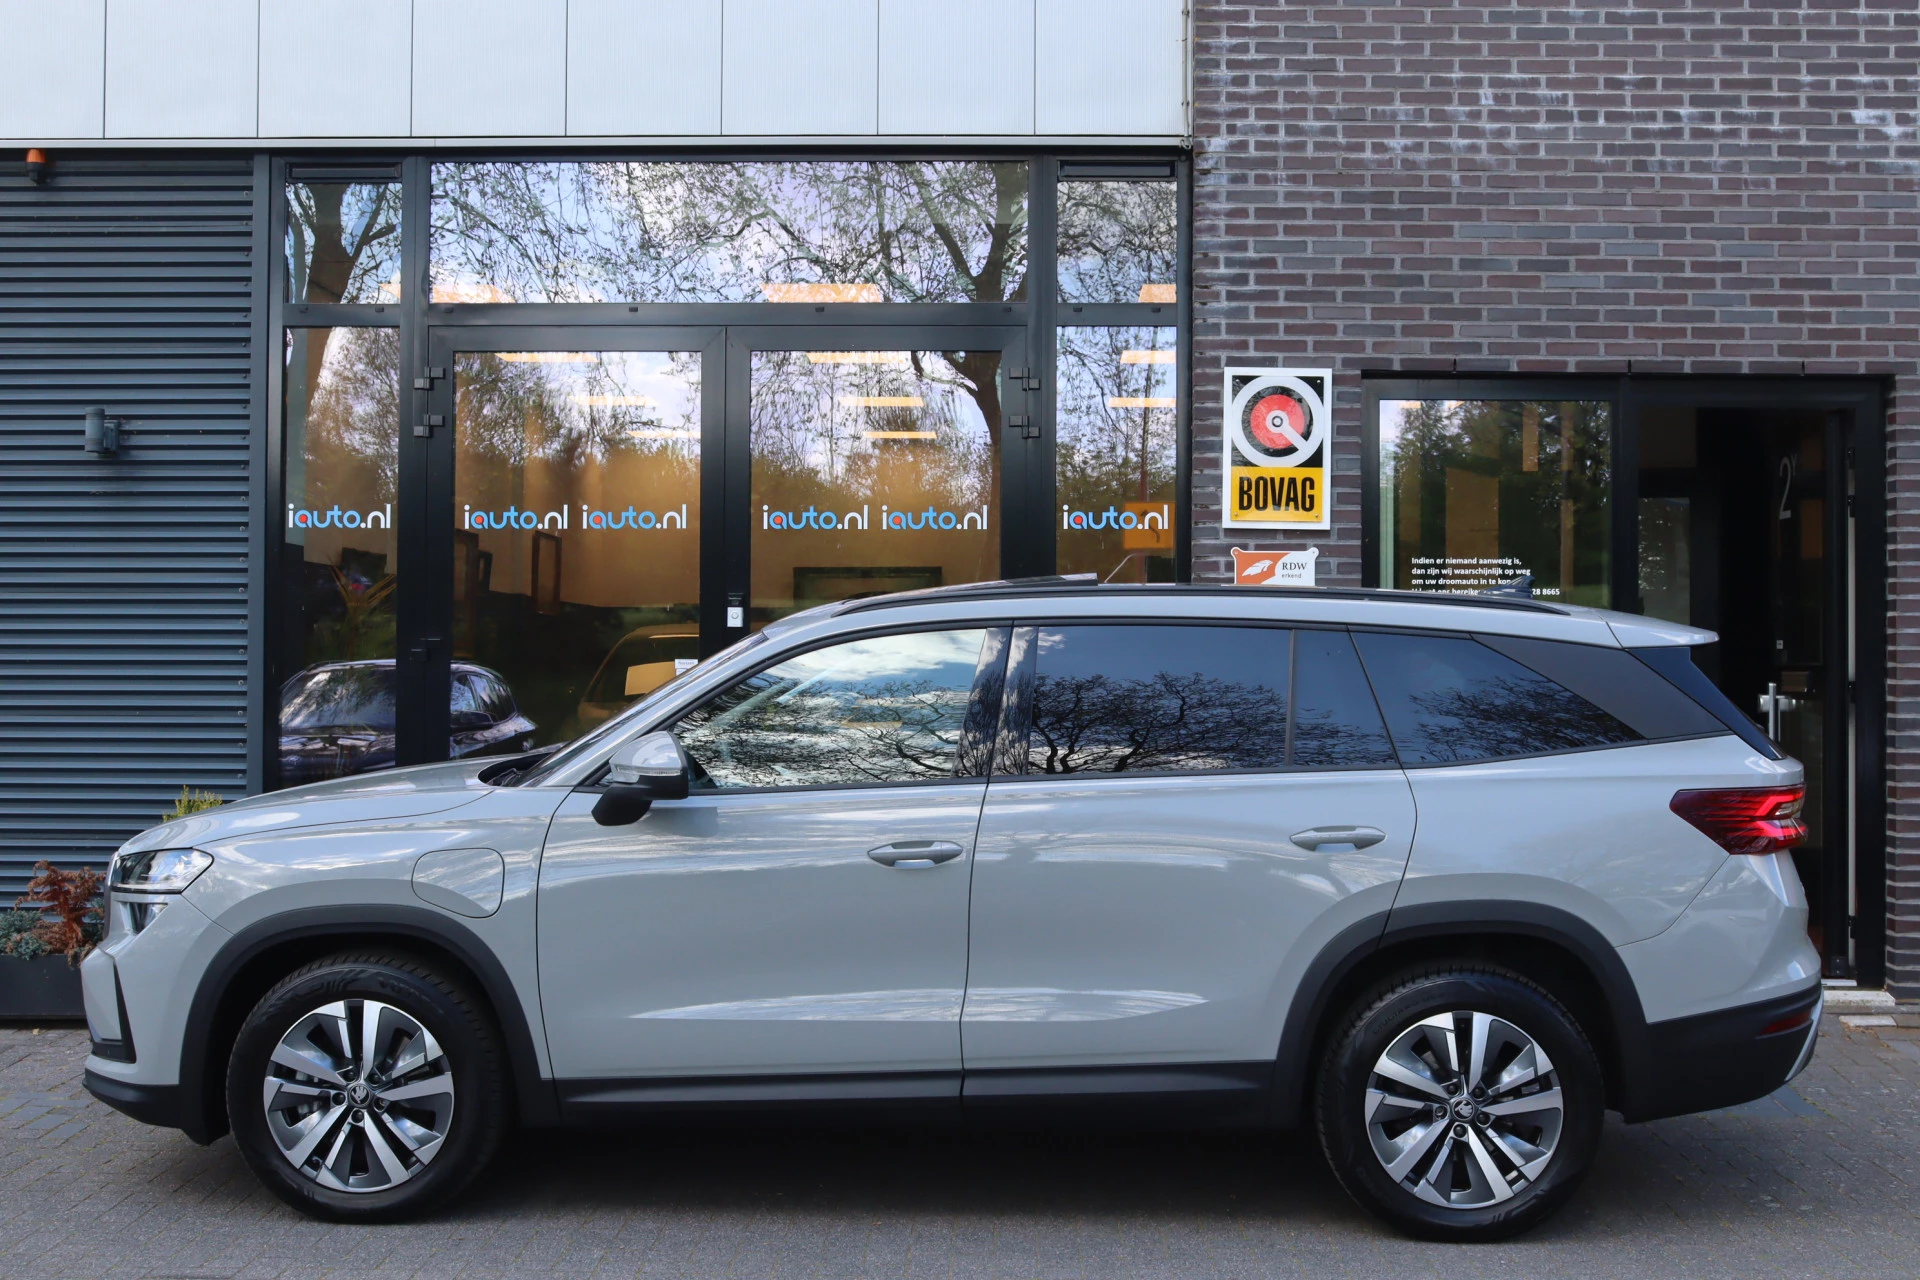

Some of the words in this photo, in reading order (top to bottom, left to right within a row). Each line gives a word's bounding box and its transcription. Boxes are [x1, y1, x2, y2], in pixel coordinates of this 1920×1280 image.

[1239, 475, 1315, 512] BOVAG
[288, 503, 391, 529] iauto.nl
[464, 503, 569, 530] iauto.nl
[582, 503, 687, 530] iauto.nl
[762, 504, 869, 530] iauto.nl
[881, 504, 988, 530] iauto.nl
[1062, 504, 1169, 530] iauto.nl
[1281, 562, 1308, 571] RDW
[1411, 557, 1435, 565] Indien
[1445, 557, 1477, 565] niemand
[1478, 557, 1512, 566] aanwezig
[1513, 557, 1522, 566] is,
[1411, 567, 1425, 575] dan
[1426, 567, 1440, 576] zijn
[1441, 567, 1452, 576] wij
[1453, 567, 1503, 576] waarschijnlijk
[1438, 577, 1478, 585] droomauto
[1480, 577, 1487, 585] in
[1451, 588, 1481, 596] bereike
[1542, 588, 1560, 596] 8665
